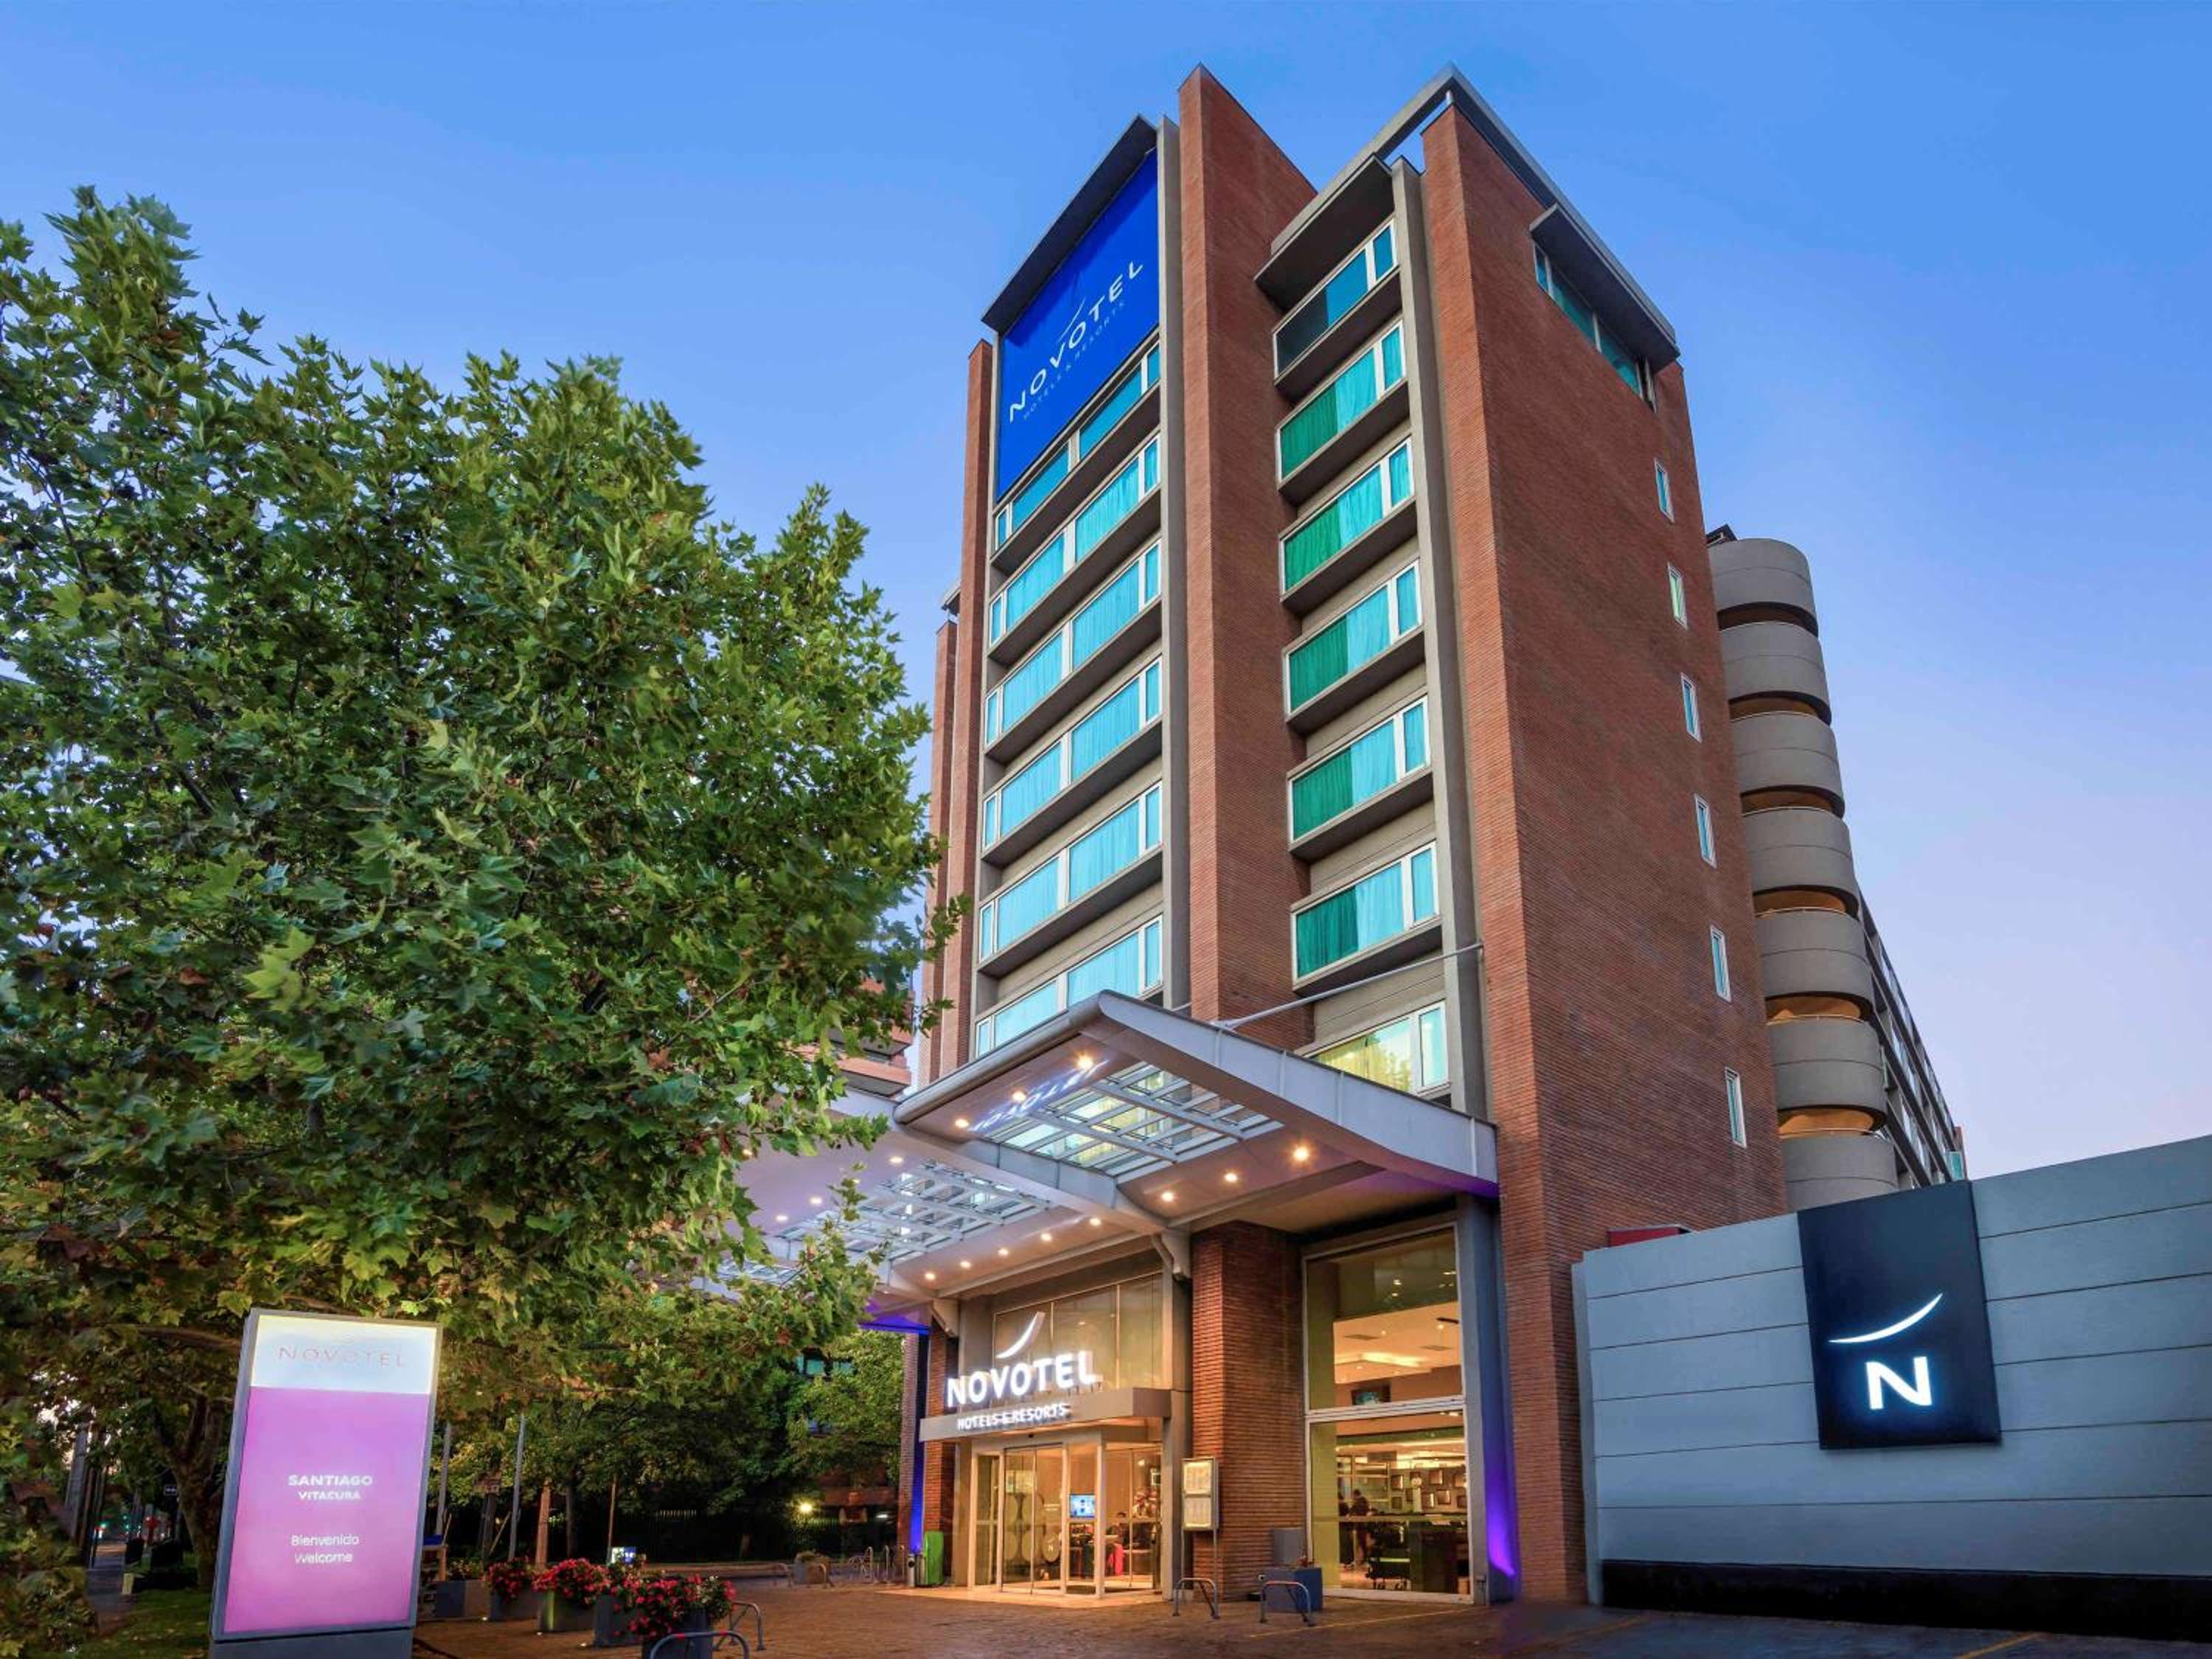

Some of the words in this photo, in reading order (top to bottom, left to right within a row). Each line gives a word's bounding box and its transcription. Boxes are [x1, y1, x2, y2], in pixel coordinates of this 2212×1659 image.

[1009, 262, 1143, 423] NOVOTEL
[947, 1351, 1102, 1408] NOVOTEL
[1865, 1356, 1933, 1409] N
[957, 1413, 999, 1430] HOTELS
[1015, 1402, 1071, 1422] RESORTS
[288, 1475, 373, 1486] SANTIAGO
[291, 1534, 360, 1546] Bienvenido
